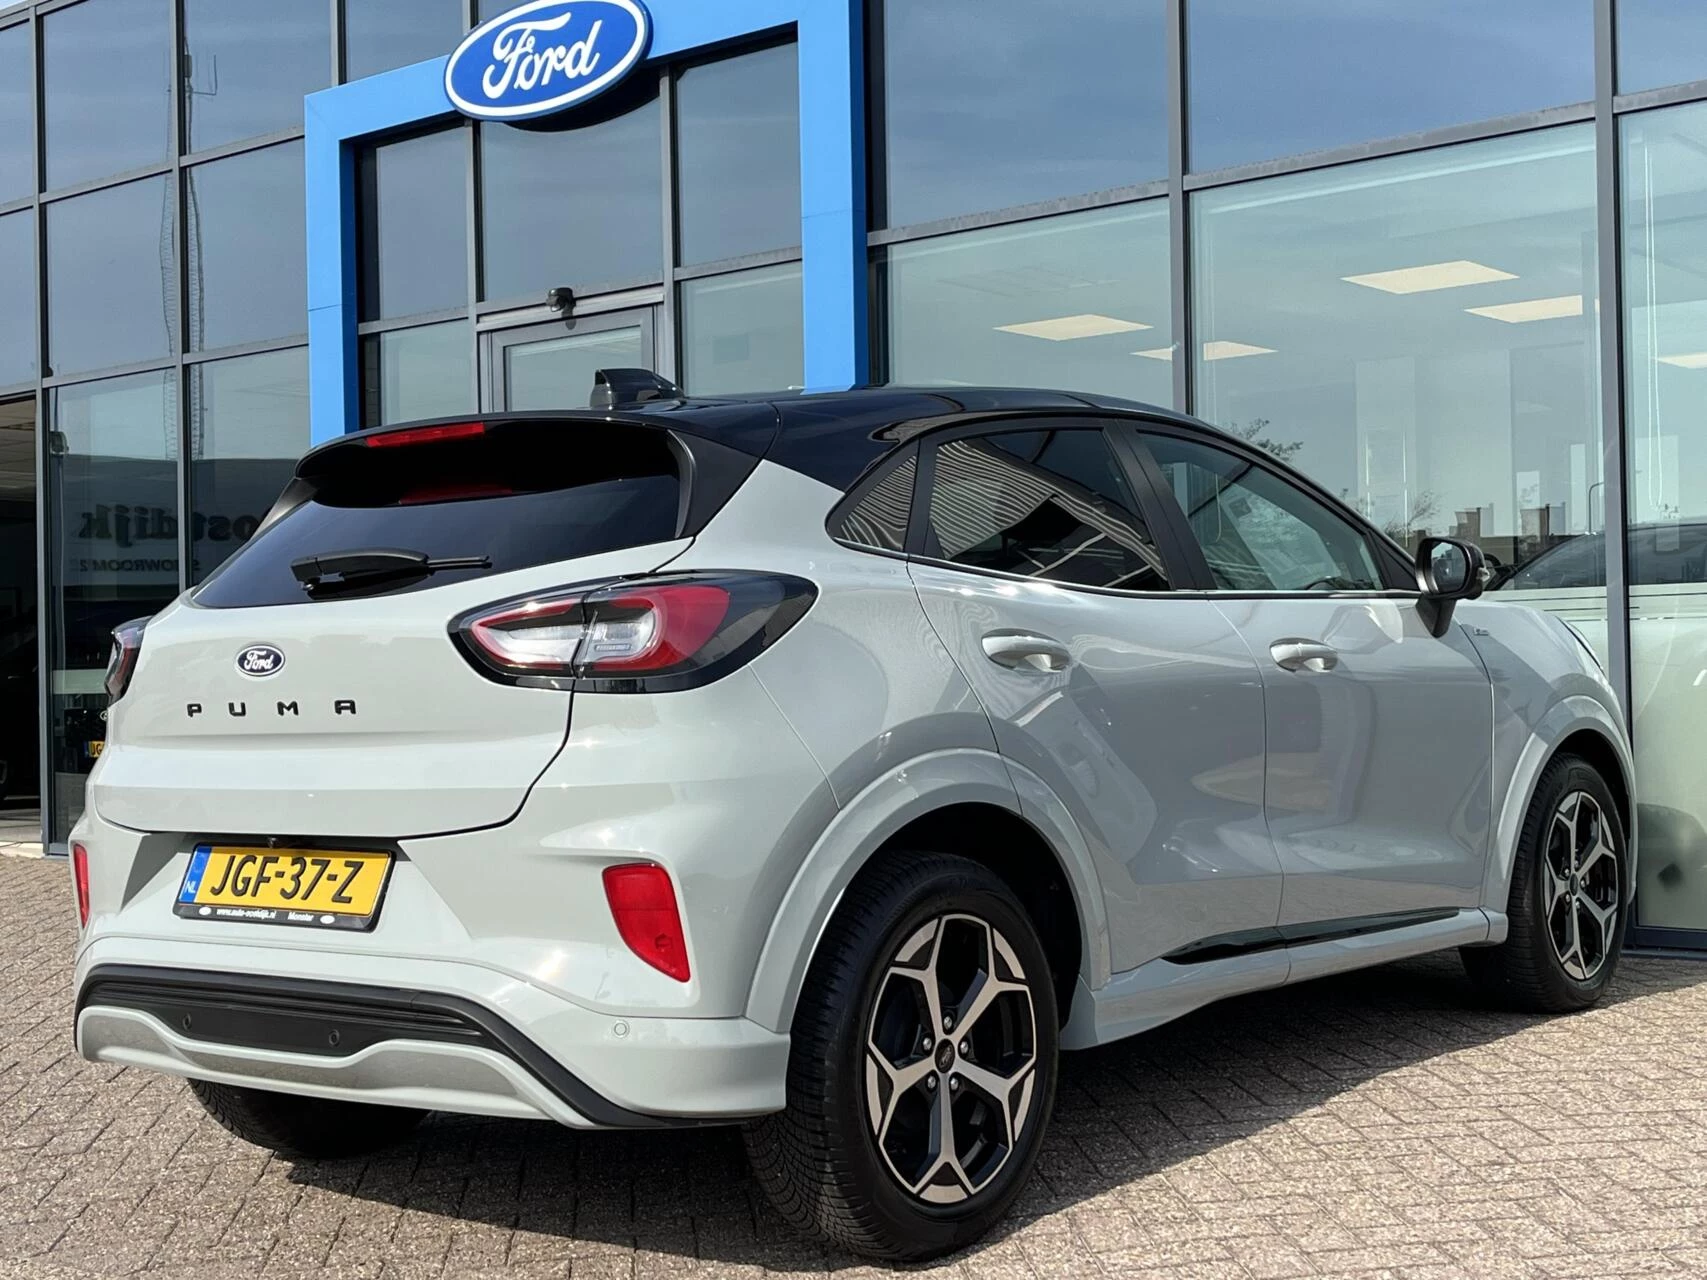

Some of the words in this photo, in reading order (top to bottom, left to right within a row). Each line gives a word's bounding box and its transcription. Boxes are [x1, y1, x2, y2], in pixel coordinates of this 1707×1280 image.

[482, 11, 603, 99] Ford
[243, 649, 275, 671] Ford
[187, 700, 357, 718] PUMA
[184, 880, 197, 894] NL
[210, 855, 365, 904] JGF-37-Z
